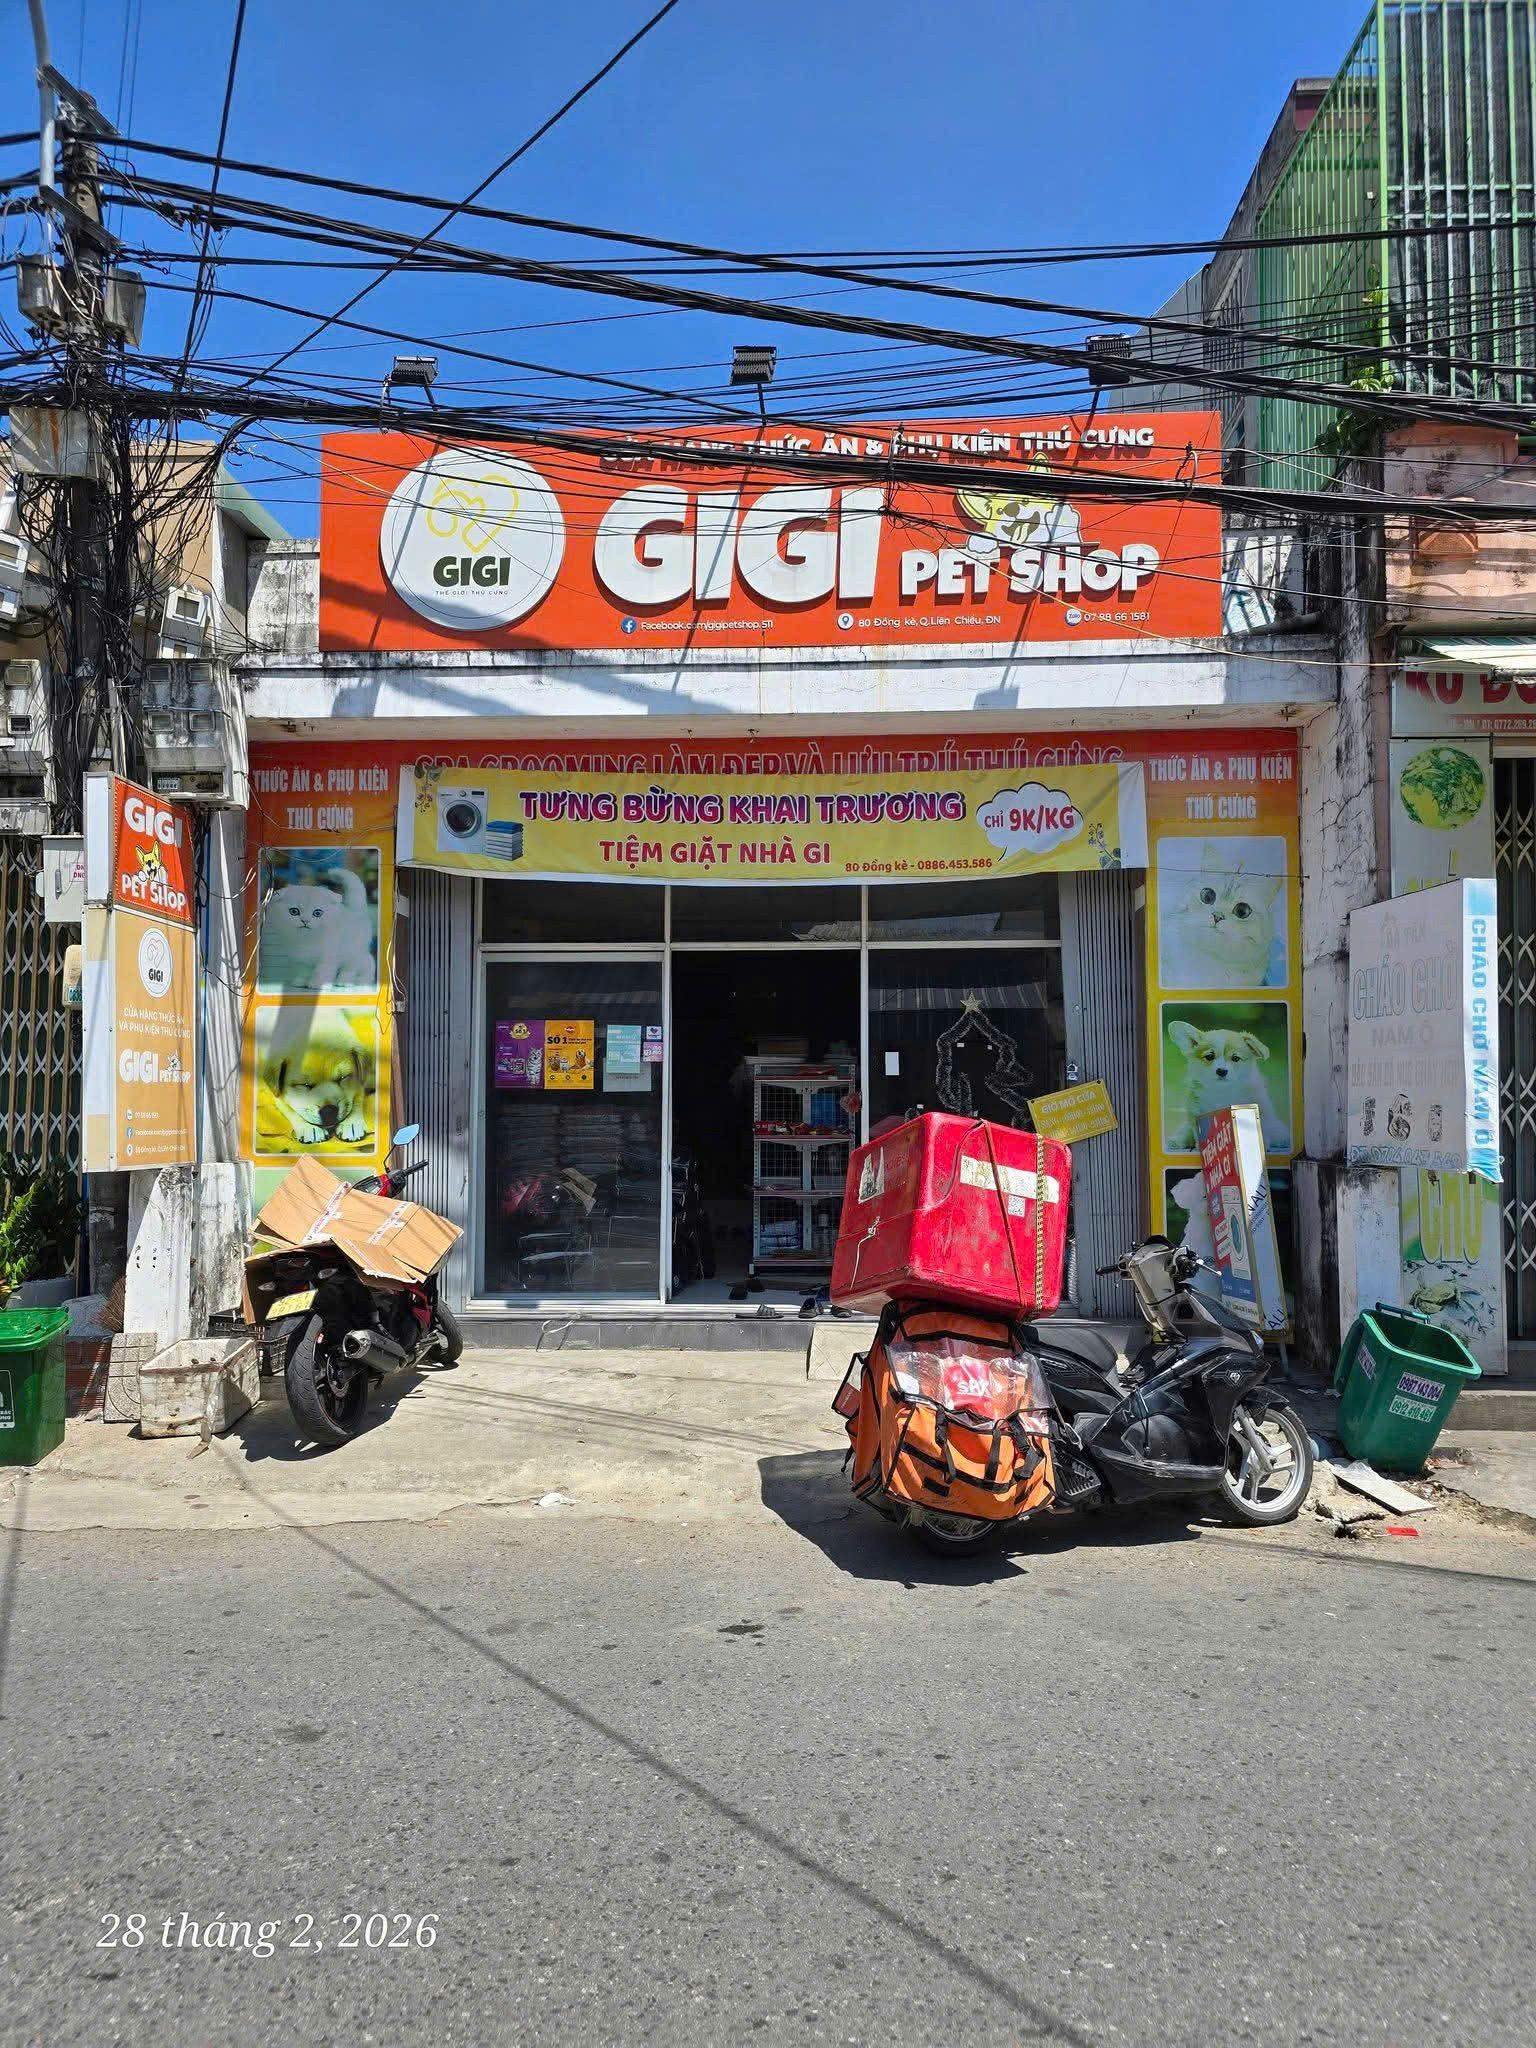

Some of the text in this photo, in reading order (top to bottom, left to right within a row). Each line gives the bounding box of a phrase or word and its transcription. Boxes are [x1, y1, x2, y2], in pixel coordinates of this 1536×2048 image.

[865, 438, 885, 456] &
[1019, 425, 1072, 451] THÚ
[1081, 425, 1154, 450] CƯNG
[594, 483, 886, 607] GIGI
[433, 555, 511, 587] GIGI
[901, 543, 1159, 596] PET SHOP
[858, 618, 871, 627] 80
[1115, 612, 1128, 621] 66
[1130, 611, 1151, 621] 1581
[252, 764, 390, 796] THỨC ĂN & PHỤ KIỆN
[1149, 752, 1293, 785] THỨC ĂN & PHỤ KIỆN
[286, 803, 354, 831] THÚ CƯNG
[519, 784, 967, 824] TƯNG BỪNG KHAI TRƯƠNG
[984, 805, 1076, 834] CHỈ 9K/KG
[1185, 792, 1258, 820] THÚ CƯNG
[124, 796, 183, 849] GIGI
[600, 834, 831, 871] TIỆM GIẶT NHÀ GI
[845, 862, 860, 872] 80
[862, 858, 892, 873] Đồng
[894, 859, 908, 871] kè
[917, 857, 993, 871] 0886.453.586
[121, 872, 187, 912] PET SHOP
[148, 967, 164, 983] GIGI
[546, 1033, 561, 1045] SỐ
[1370, 1024, 1415, 1049] NAM
[119, 1048, 159, 1084] GIGI
[1473, 1059, 1491, 1120] NAM
